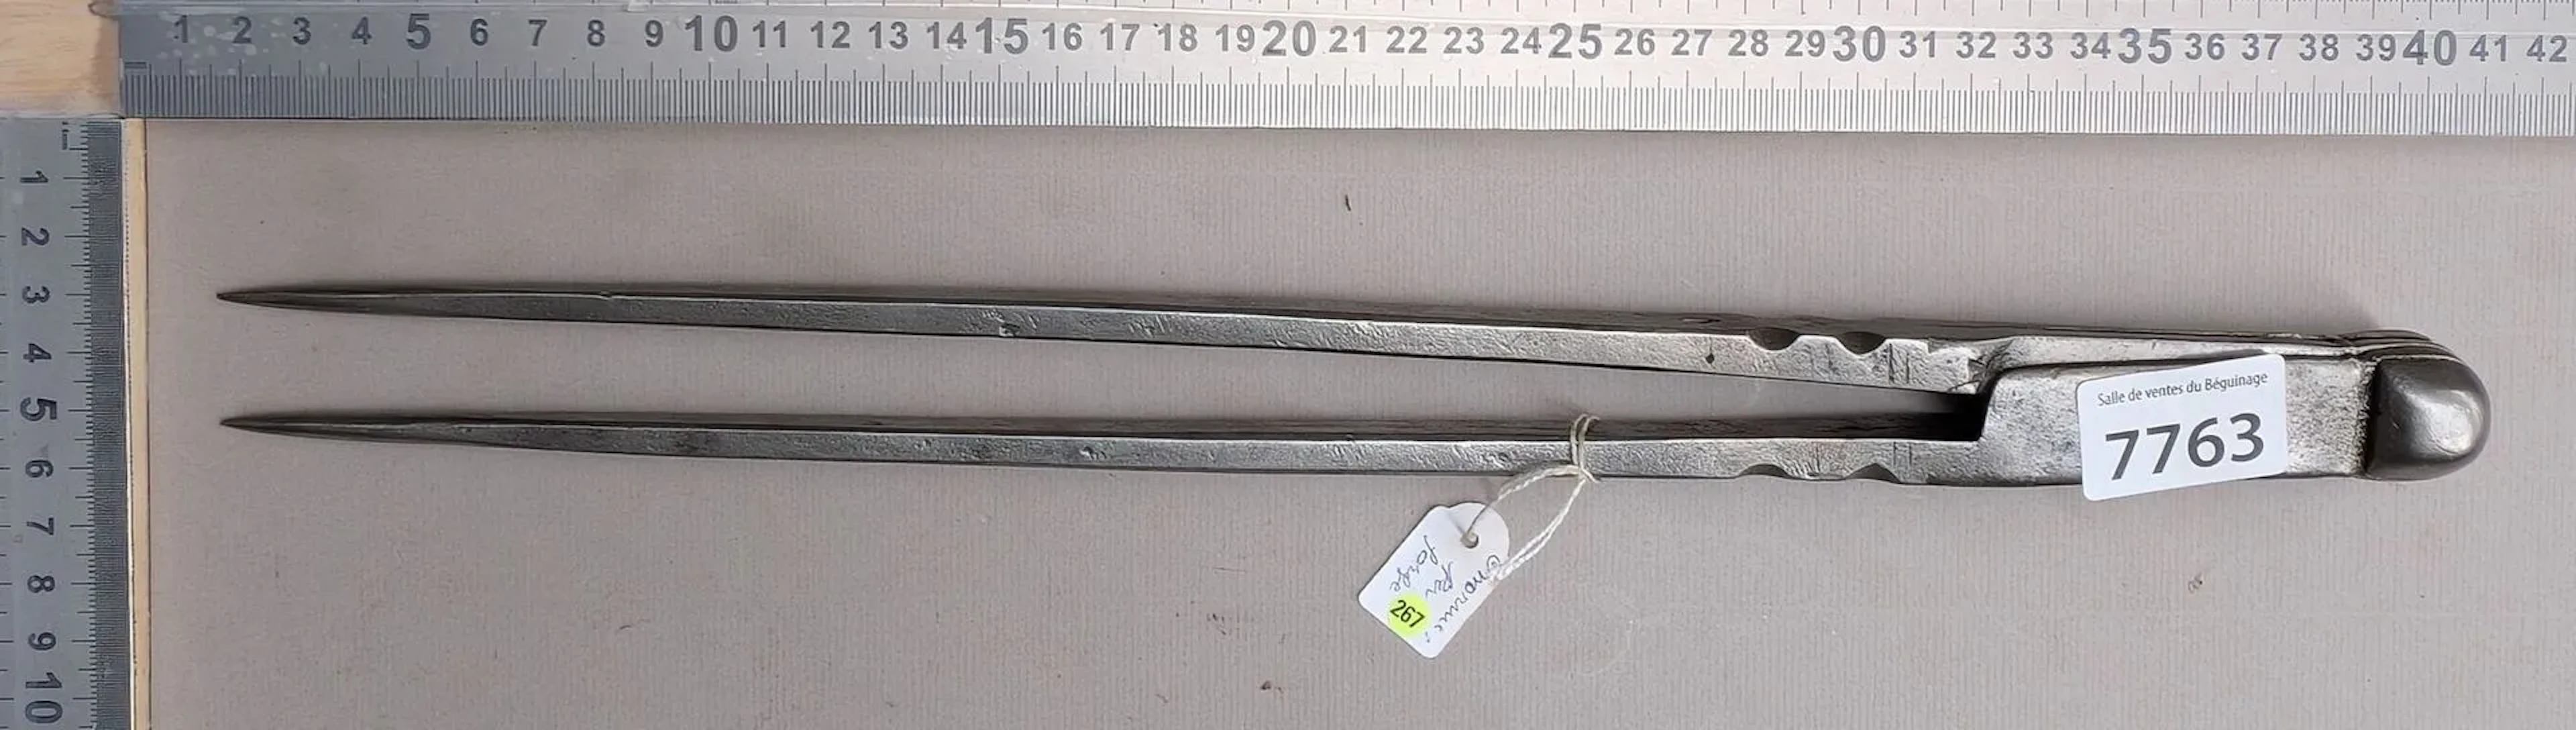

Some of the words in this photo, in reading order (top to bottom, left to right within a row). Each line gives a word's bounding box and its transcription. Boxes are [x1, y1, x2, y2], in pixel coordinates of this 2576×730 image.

[174, 15, 188, 43] 1
[233, 15, 252, 44] 2
[292, 17, 312, 45] 3
[351, 16, 372, 45] 4
[406, 13, 431, 50] 5
[470, 18, 489, 46] 6
[528, 19, 548, 46] 7
[586, 19, 606, 47] 8
[645, 19, 663, 48] 9
[685, 15, 738, 52] 10
[752, 19, 786, 48] 11
[810, 20, 851, 49] 12
[868, 21, 908, 50] 13
[926, 21, 967, 50] 14
[975, 17, 1028, 55] 15
[1042, 22, 1083, 51] 16
[1099, 22, 1140, 51] 17
[1157, 22, 1198, 52] 18
[1215, 23, 1255, 53] 19
[1261, 19, 1317, 57] 20
[1328, 25, 1366, 53] 21
[1385, 25, 1428, 54] 22
[1443, 25, 1485, 55] 23
[1499, 26, 1542, 55] 24
[1548, 22, 1603, 60] 25
[1613, 28, 1656, 56] 26
[1670, 28, 1714, 56] 27
[1727, 28, 1769, 57] 28
[1784, 29, 1826, 58] 29
[1832, 25, 1886, 63] 30
[1898, 30, 1937, 58] 31
[1955, 31, 1997, 59] 32
[2012, 32, 2053, 60] 33
[2070, 32, 2112, 60] 34
[2117, 28, 2172, 64] 35
[2184, 32, 2226, 60] 36
[2241, 33, 2283, 61] 37
[2298, 33, 2339, 62] 38
[2355, 34, 2396, 62] 39
[2402, 29, 2457, 66] 40
[2469, 34, 2507, 62] 41
[2526, 34, 2567, 62] 42
[19, 170, 49, 184] 1
[21, 227, 50, 246] 2
[22, 285, 50, 304] 3
[23, 343, 52, 364] 4
[2097, 393, 2126, 407] Salle
[2127, 388, 2143, 401] de
[2145, 384, 2184, 399] ventes
[2186, 379, 2202, 394] du
[2204, 372, 2269, 392] Béguinage
[19, 397, 58, 422] 5
[2105, 412, 2265, 481] 7763
[25, 459, 54, 478] 6
[26, 517, 54, 536] 7
[27, 574, 56, 594] 8
[1389, 599, 1426, 629] 267
[28, 631, 57, 651] 9
[25, 672, 63, 724] 10
